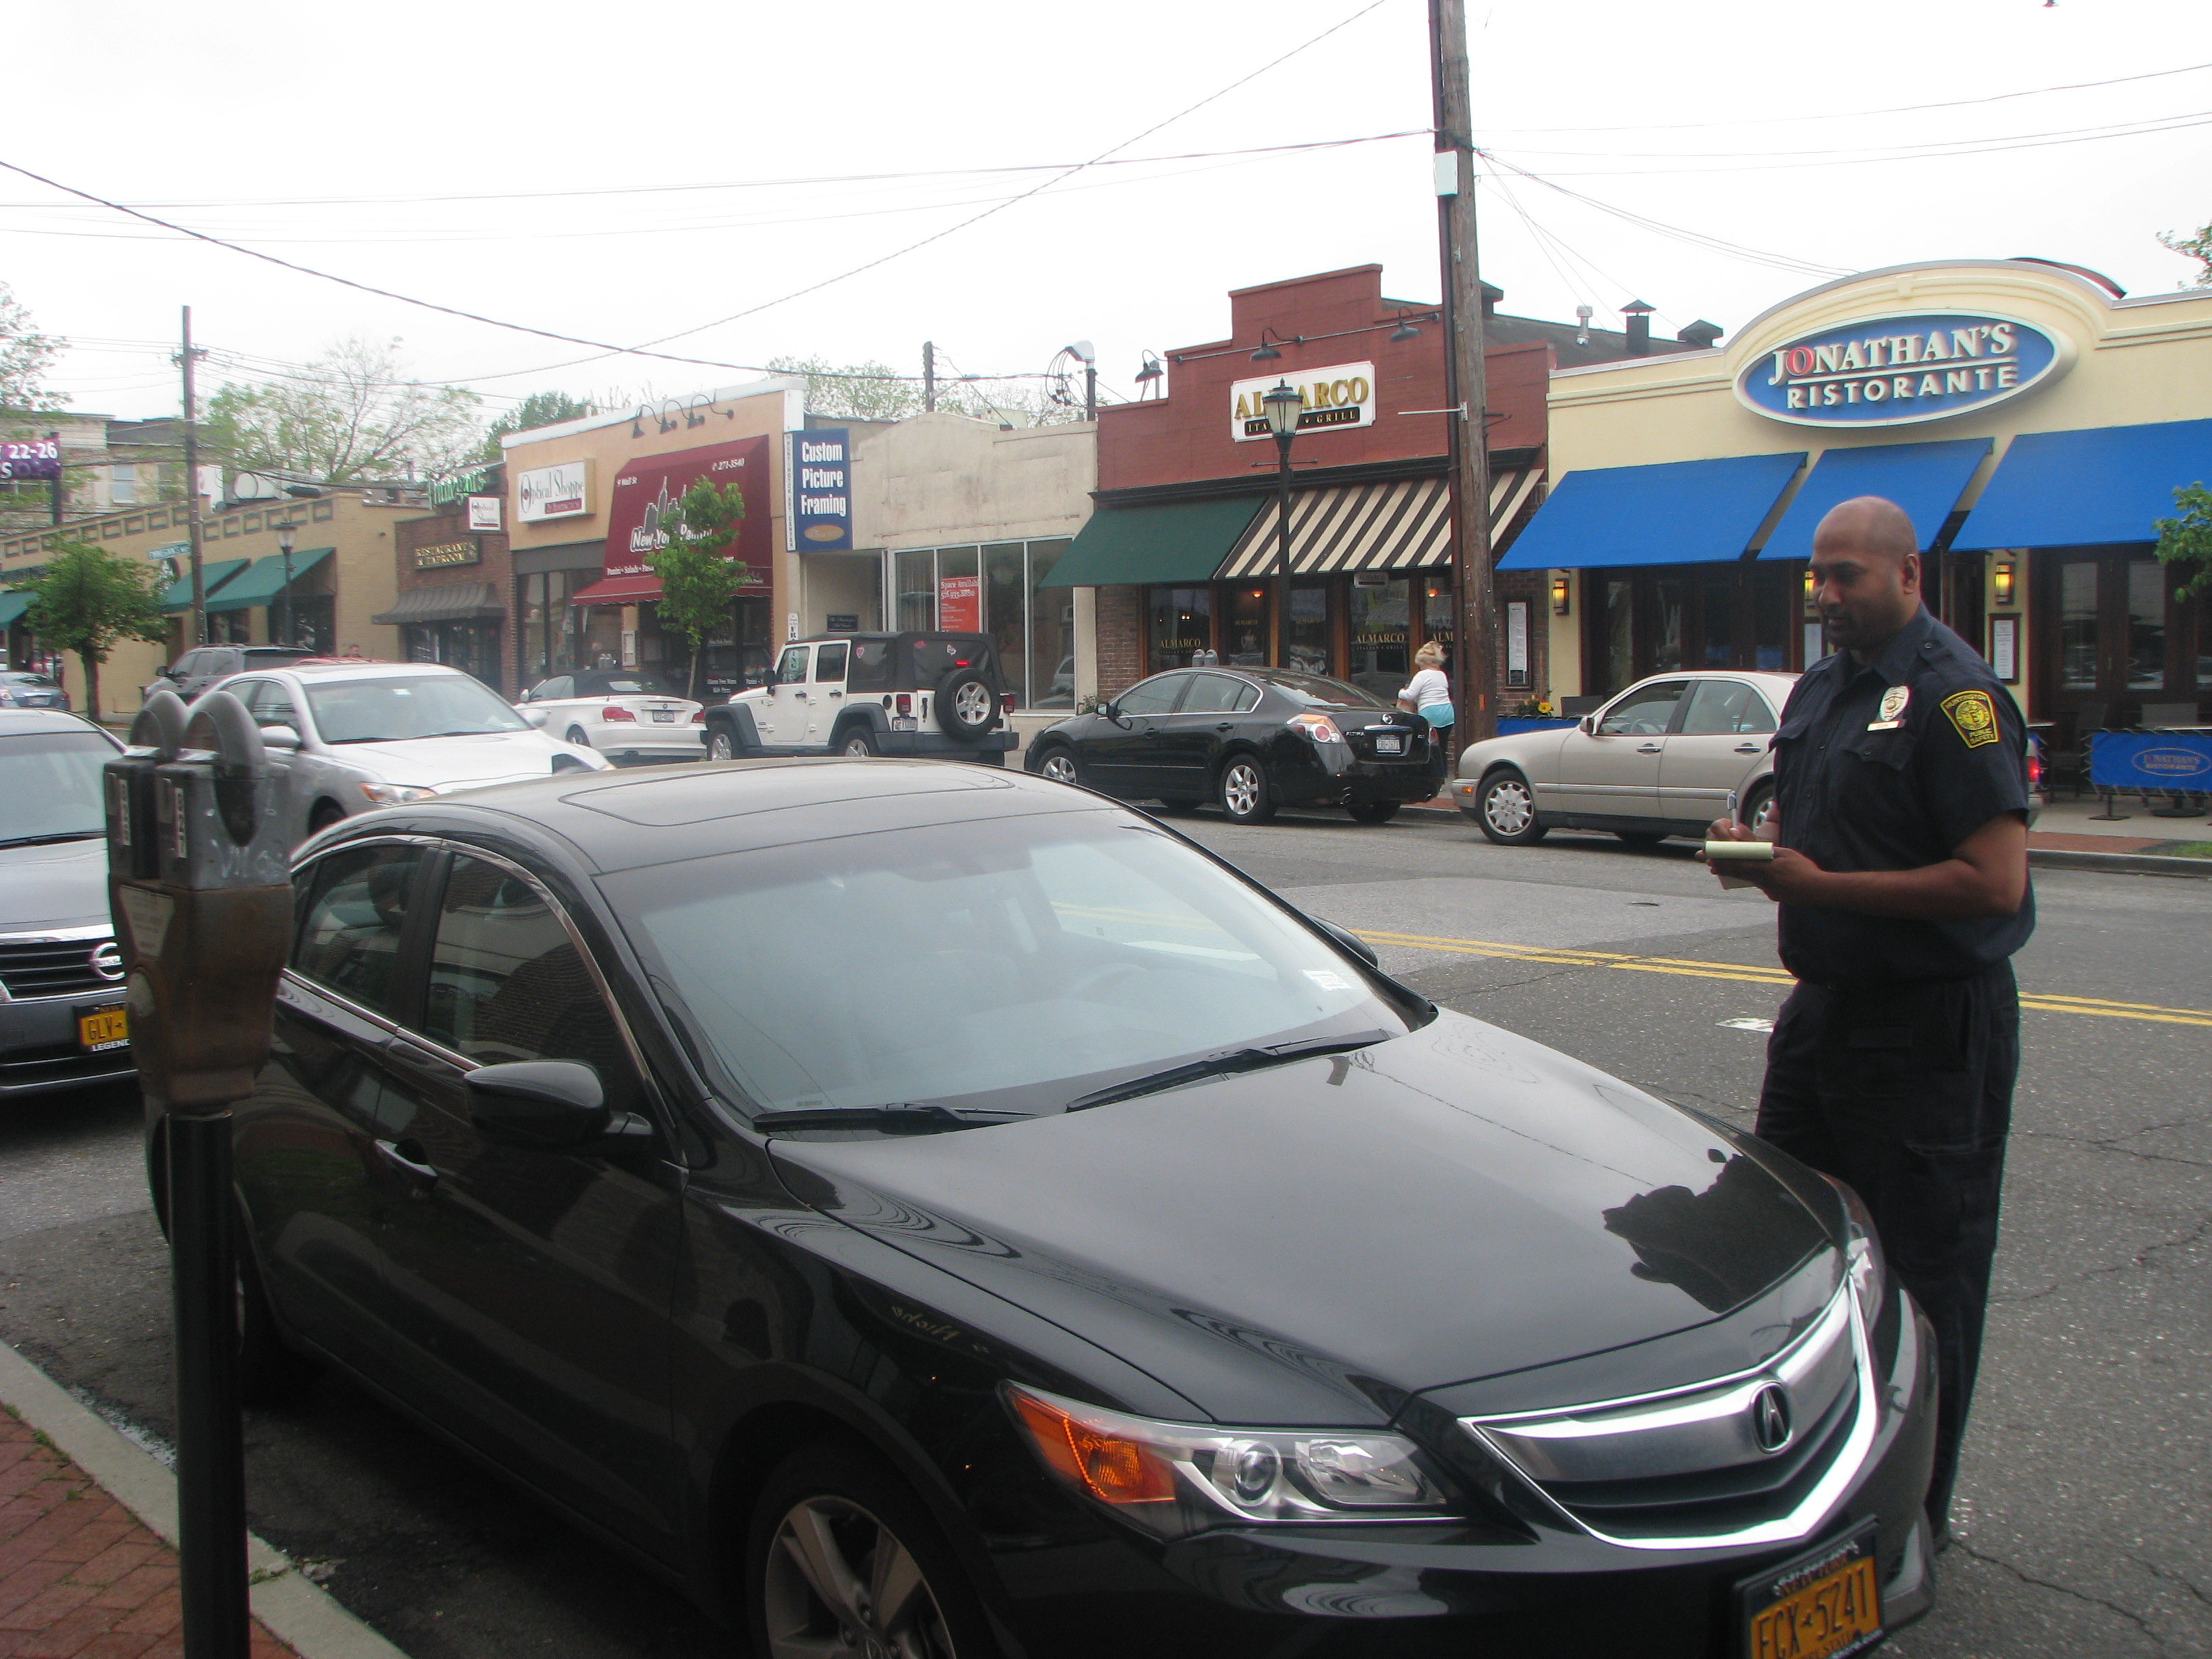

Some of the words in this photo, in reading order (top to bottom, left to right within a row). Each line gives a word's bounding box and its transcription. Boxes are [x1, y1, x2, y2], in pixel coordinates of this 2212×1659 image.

[1767, 323, 2015, 386] JONATHAN'S
[1786, 365, 2017, 409] RISTORANTE
[1234, 377, 1368, 419] ALARCO
[1316, 411, 1355, 424] GRILL
[8, 442, 58, 459] 22-26
[802, 442, 842, 462] Custom
[802, 468, 844, 489] Picture
[520, 471, 552, 514] Optical
[554, 470, 584, 499] Shoppe
[800, 494, 846, 517] Framing
[941, 581, 956, 590] Space
[1160, 638, 1201, 648] ALMARCO
[1357, 633, 1405, 643] ALMARCO
